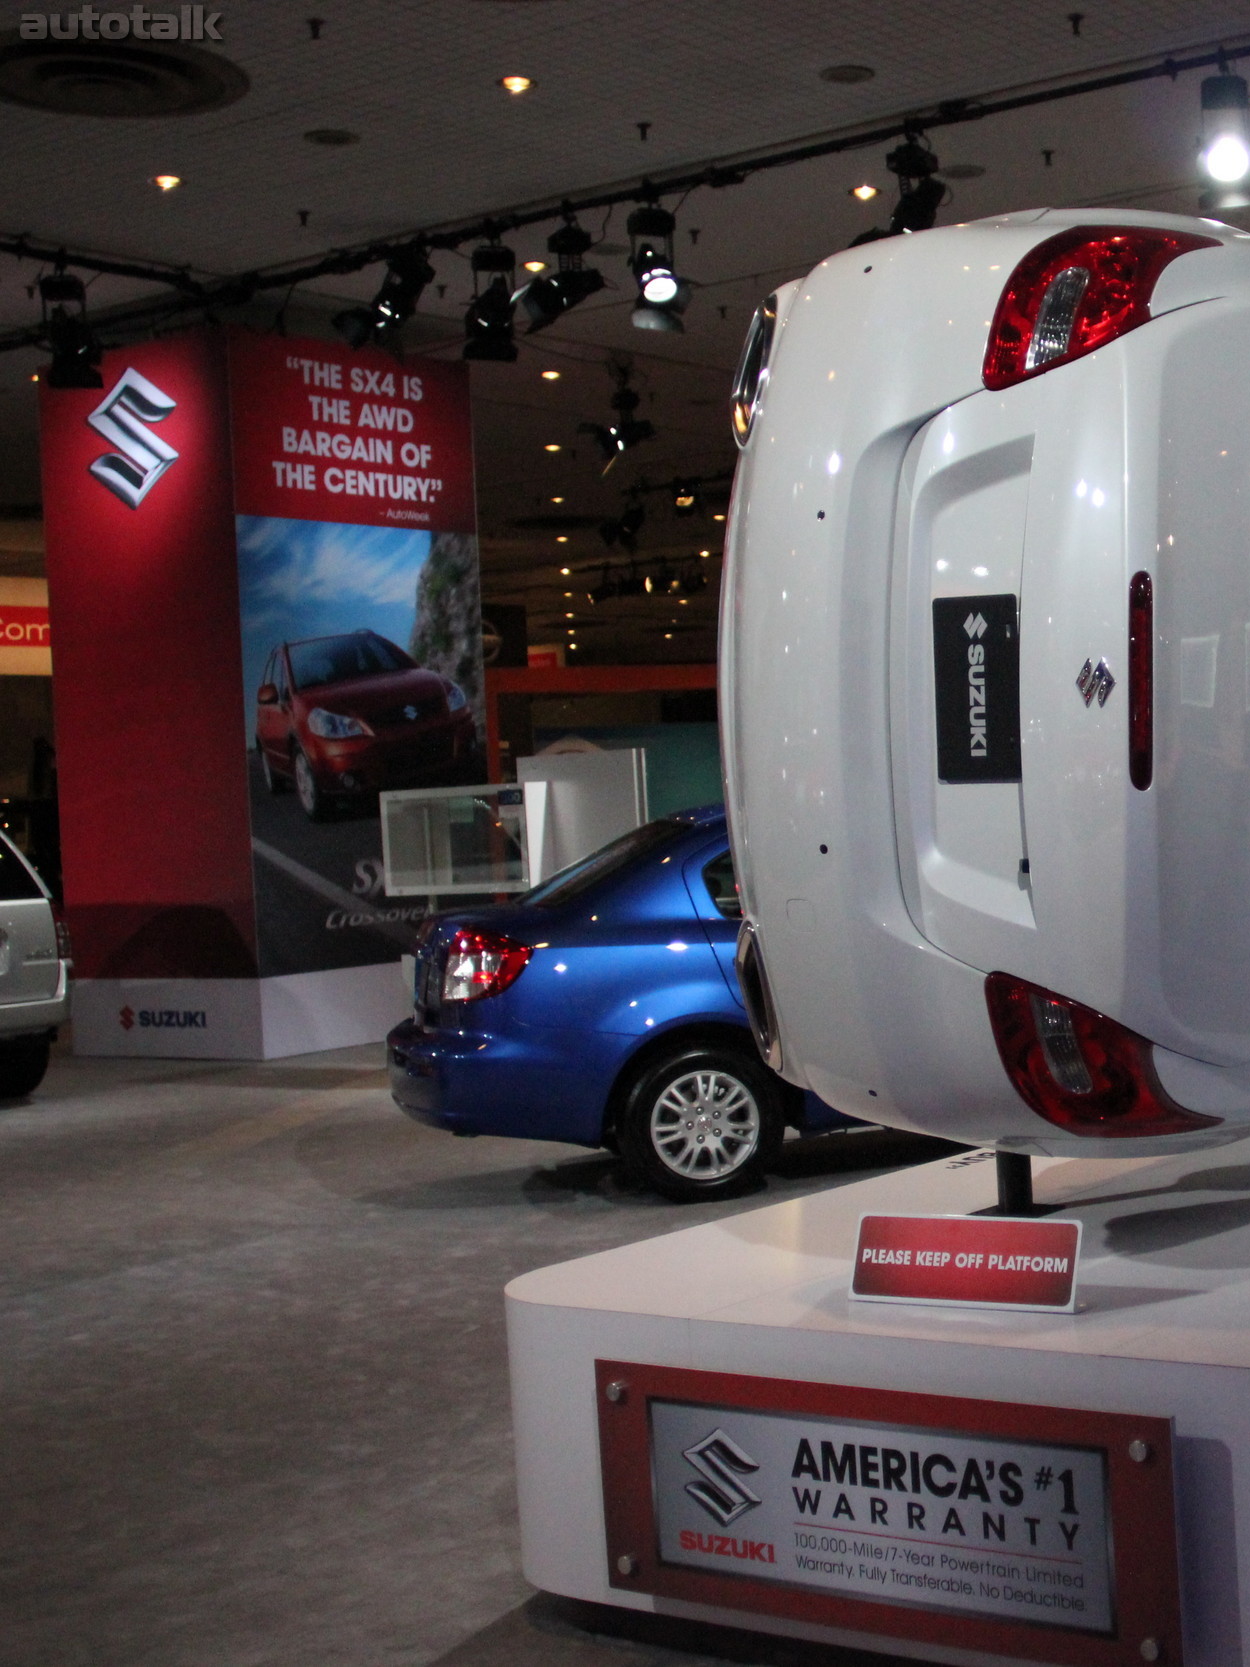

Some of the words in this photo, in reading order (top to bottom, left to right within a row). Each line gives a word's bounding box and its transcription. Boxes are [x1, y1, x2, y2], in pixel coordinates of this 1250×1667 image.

[350, 367, 396, 397] SX4
[403, 375, 423, 401] IS
[308, 395, 350, 425] THE
[357, 403, 414, 433] AWD
[282, 426, 393, 464] BARGAIN
[401, 442, 432, 468] OF
[272, 460, 316, 490] THE
[386, 507, 430, 522] AutoWeek
[967, 644, 987, 757] SUZUKI
[138, 1010, 206, 1028] SUZUKI
[862, 1248, 911, 1266] PLEASE
[915, 1251, 950, 1268] KEEP
[955, 1253, 984, 1269] OFF
[988, 1254, 1068, 1274] PLATFORM
[1034, 1466, 1079, 1515] #1
[792, 1486, 1080, 1551] WARRANTY
[679, 1530, 776, 1564] SUZUKI
[794, 1532, 935, 1567] 100,000-Mile/7-Year
[940, 1554, 1020, 1579] Powertrain
[1026, 1566, 1084, 1589] Limited
[795, 1555, 855, 1579] Warranty.
[859, 1564, 887, 1585] Fully
[891, 1569, 975, 1596] Transferable.
[979, 1582, 1000, 1599] No
[1003, 1586, 1088, 1612] Deductible.
